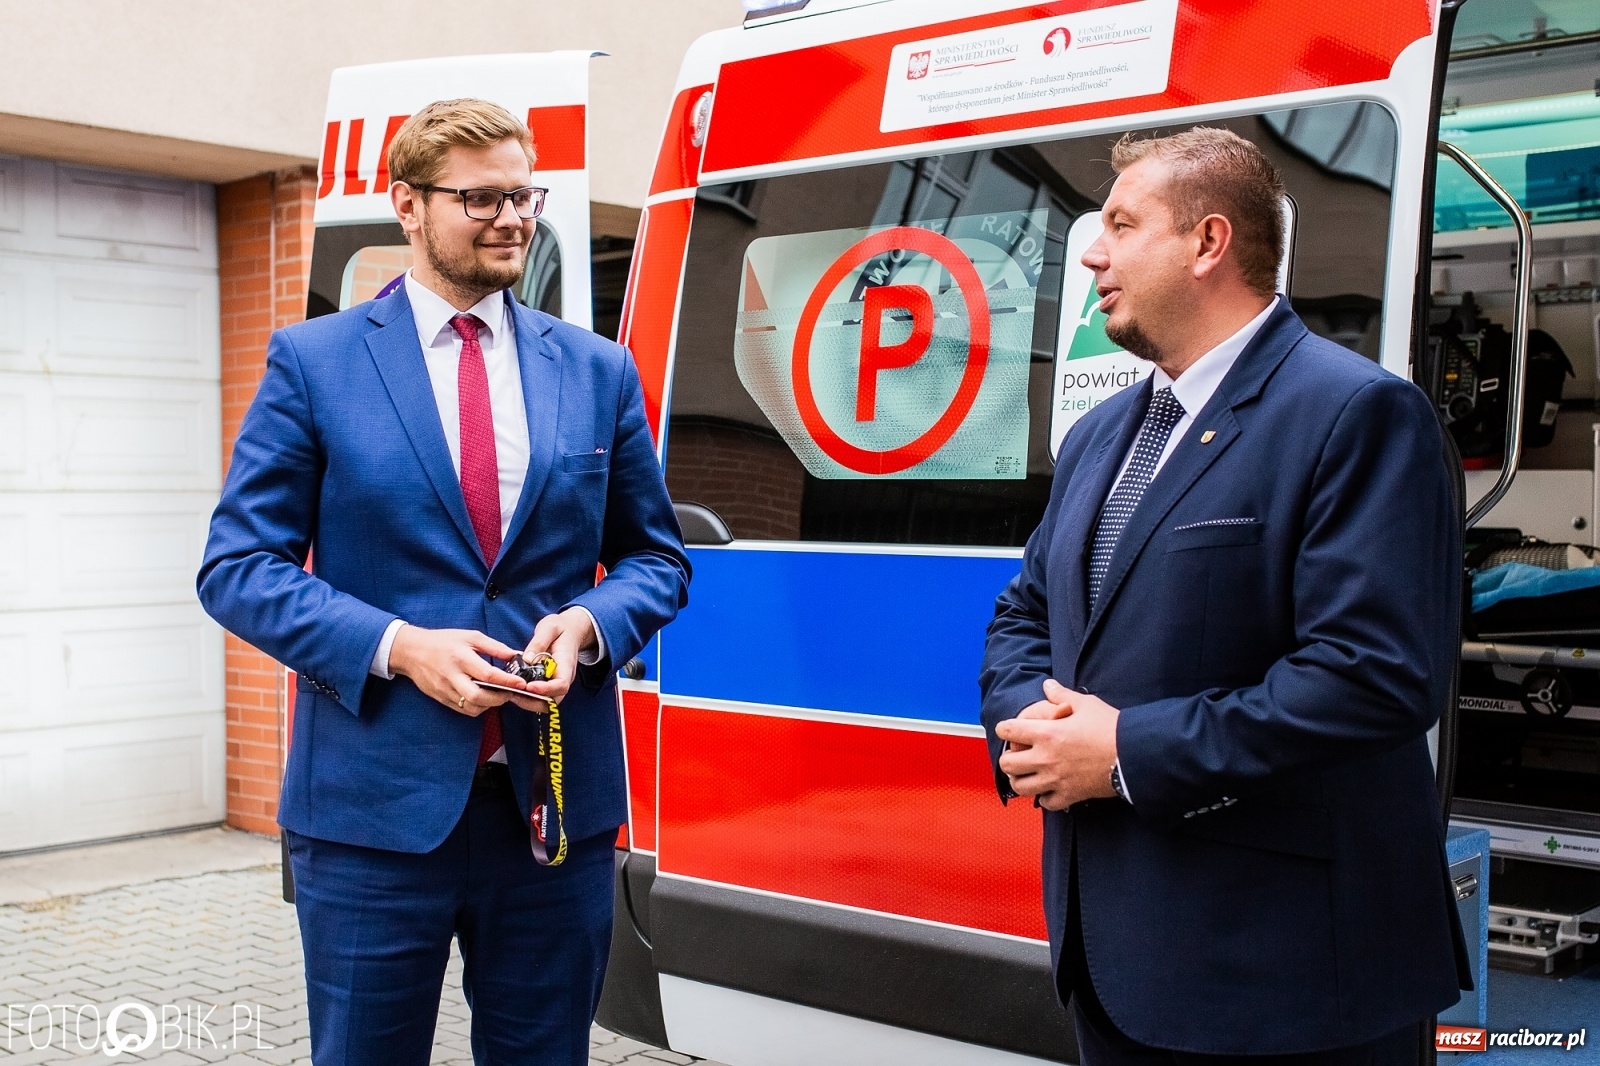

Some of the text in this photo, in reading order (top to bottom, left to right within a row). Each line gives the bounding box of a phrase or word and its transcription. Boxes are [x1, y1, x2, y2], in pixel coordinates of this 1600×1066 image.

[1077, 25, 1153, 44] SPRAWIEDLIWOŚCI
[1078, 23, 1116, 36] FUNDUSZ
[934, 44, 1019, 66] SPRAWIEDLIWOŚCI
[936, 37, 1005, 56] MINISTERSTWO
[984, 85, 993, 93] ze
[993, 79, 1024, 90] środków
[1030, 73, 1065, 86] Funduszu
[928, 102, 954, 114] którego
[954, 96, 1001, 110] dysponentem
[1001, 94, 1015, 105] jest
[1017, 89, 1047, 101] Minister
[855, 284, 935, 422] P
[1062, 365, 1139, 396] powiat
[1460, 698, 1506, 710] MONDIAL
